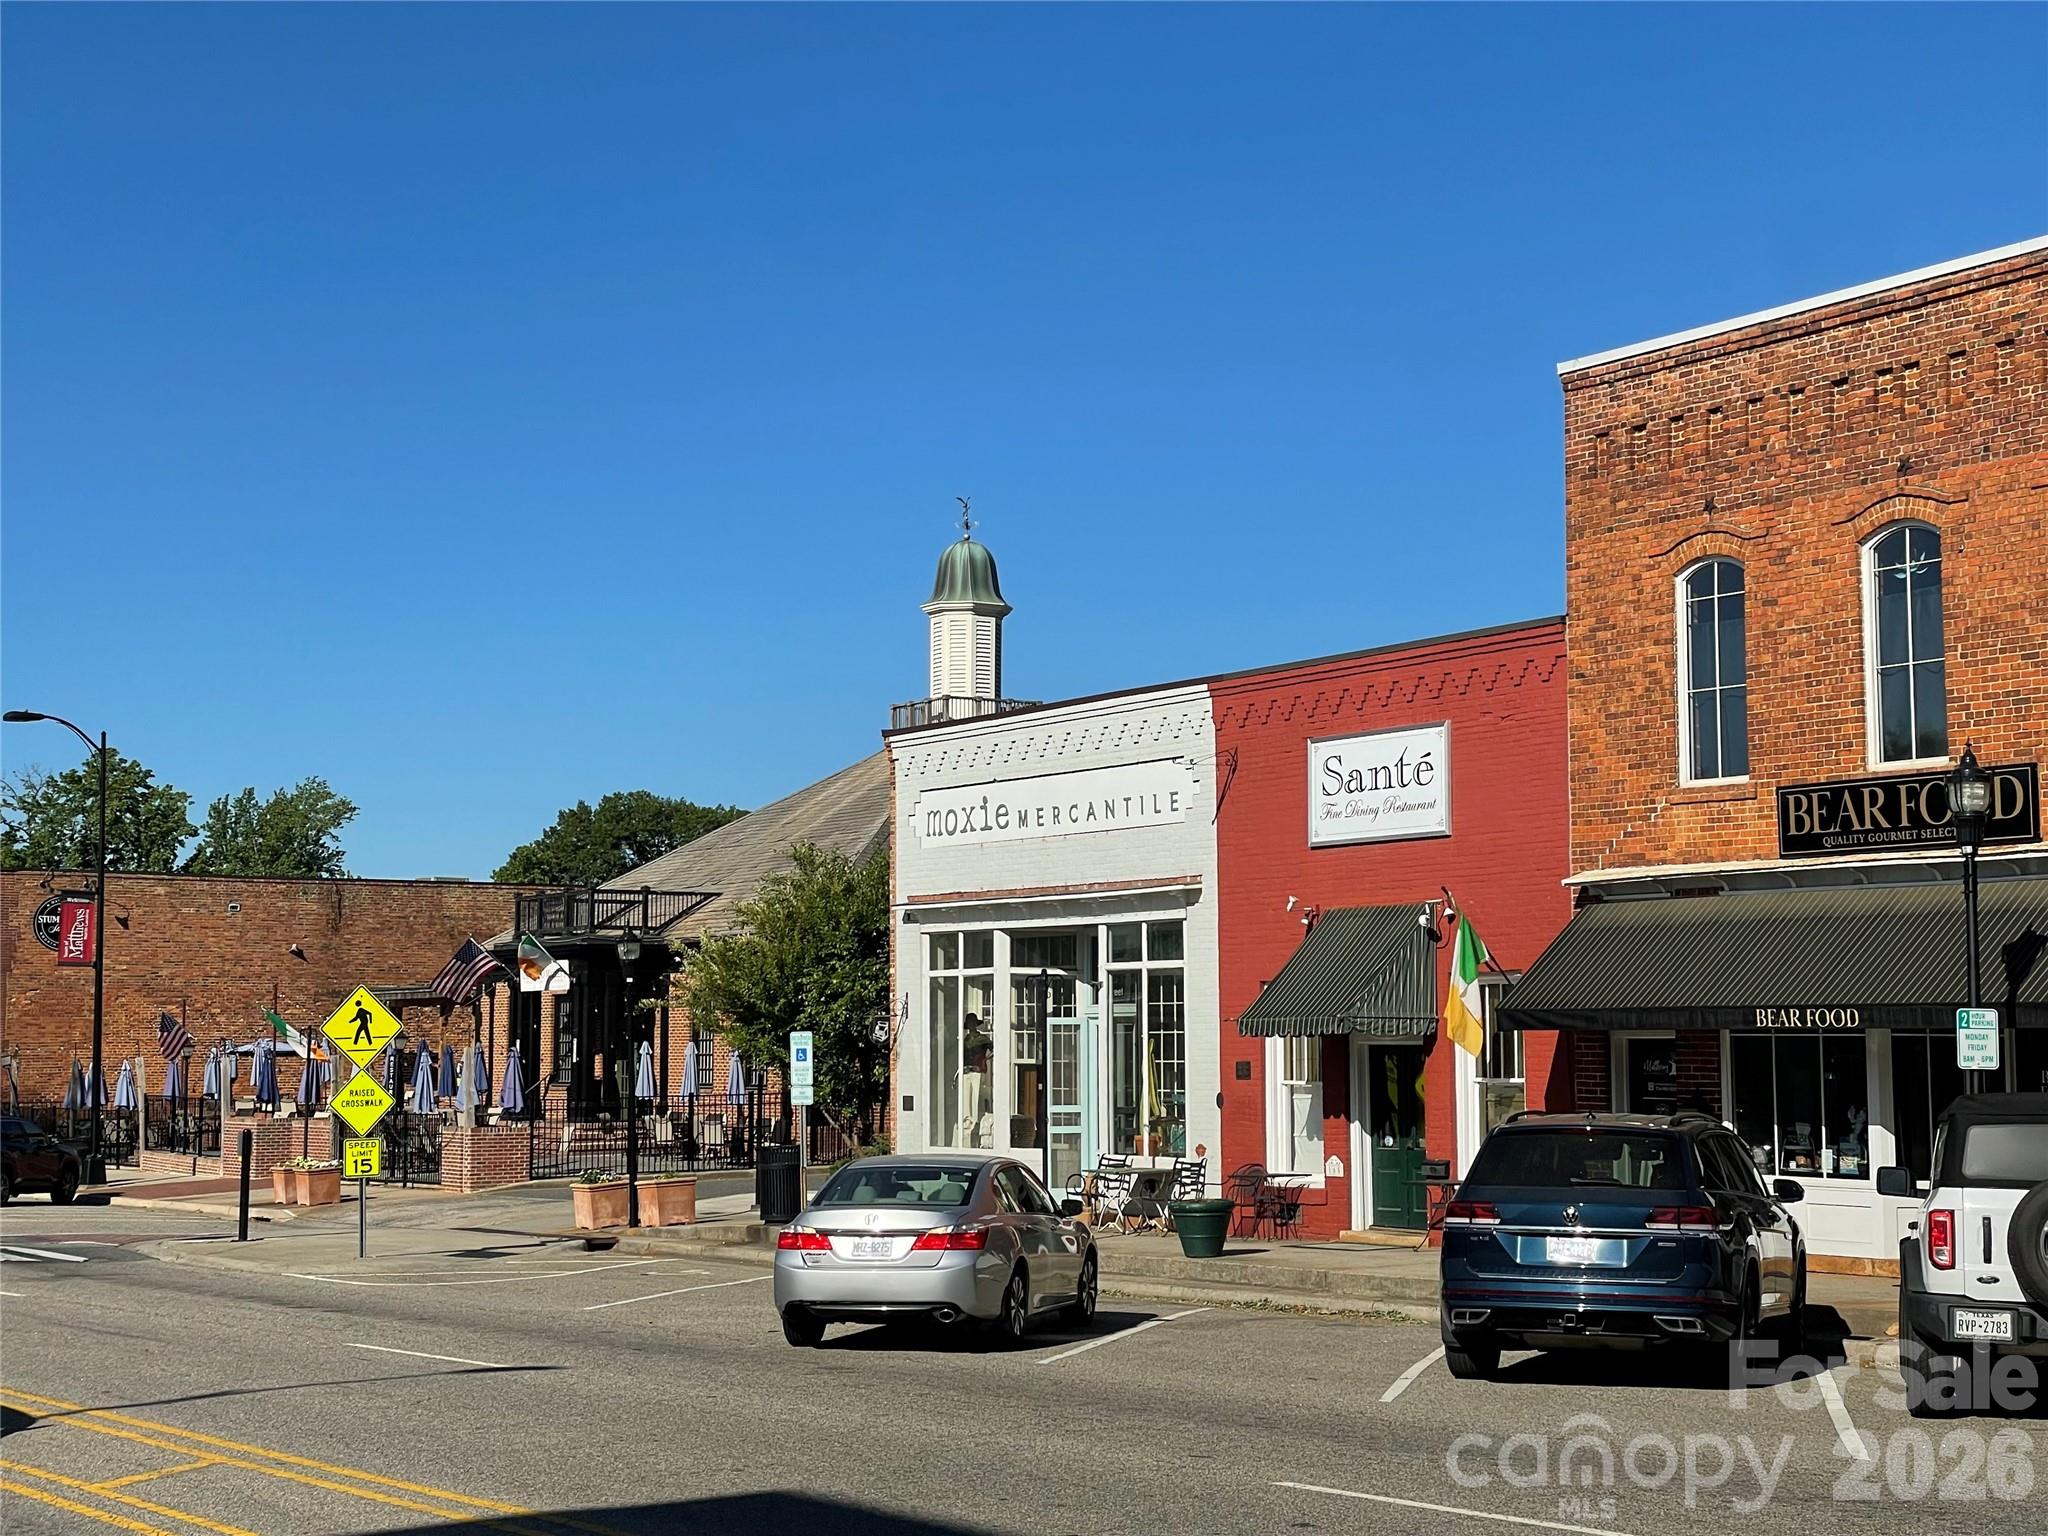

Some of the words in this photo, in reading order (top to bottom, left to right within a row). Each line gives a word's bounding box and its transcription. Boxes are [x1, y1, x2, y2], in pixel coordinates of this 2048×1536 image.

[1322, 746, 1434, 796] Santé
[926, 796, 1009, 837] moxie
[1018, 791, 1179, 829] MERCANTILE
[1320, 802, 1342, 821] Fine
[1345, 799, 1380, 823] Dining
[1383, 795, 1437, 814] Restaurant
[1786, 787, 1892, 836] BEAR
[1896, 774, 2024, 827] FOD
[1823, 834, 1865, 847] QUALITY
[1868, 830, 1919, 842] GOURMET
[1920, 827, 1957, 839] SELECT
[38, 915, 60, 924] STUM
[67, 908, 86, 958] Matthews
[1756, 1008, 1802, 1027] BEAR
[1806, 1008, 1859, 1028] FOOD
[1961, 1012, 1968, 1027] 2
[349, 1088, 375, 1097] RAISED
[341, 1099, 383, 1108] CROSSWALK
[353, 1159, 372, 1174] 15
